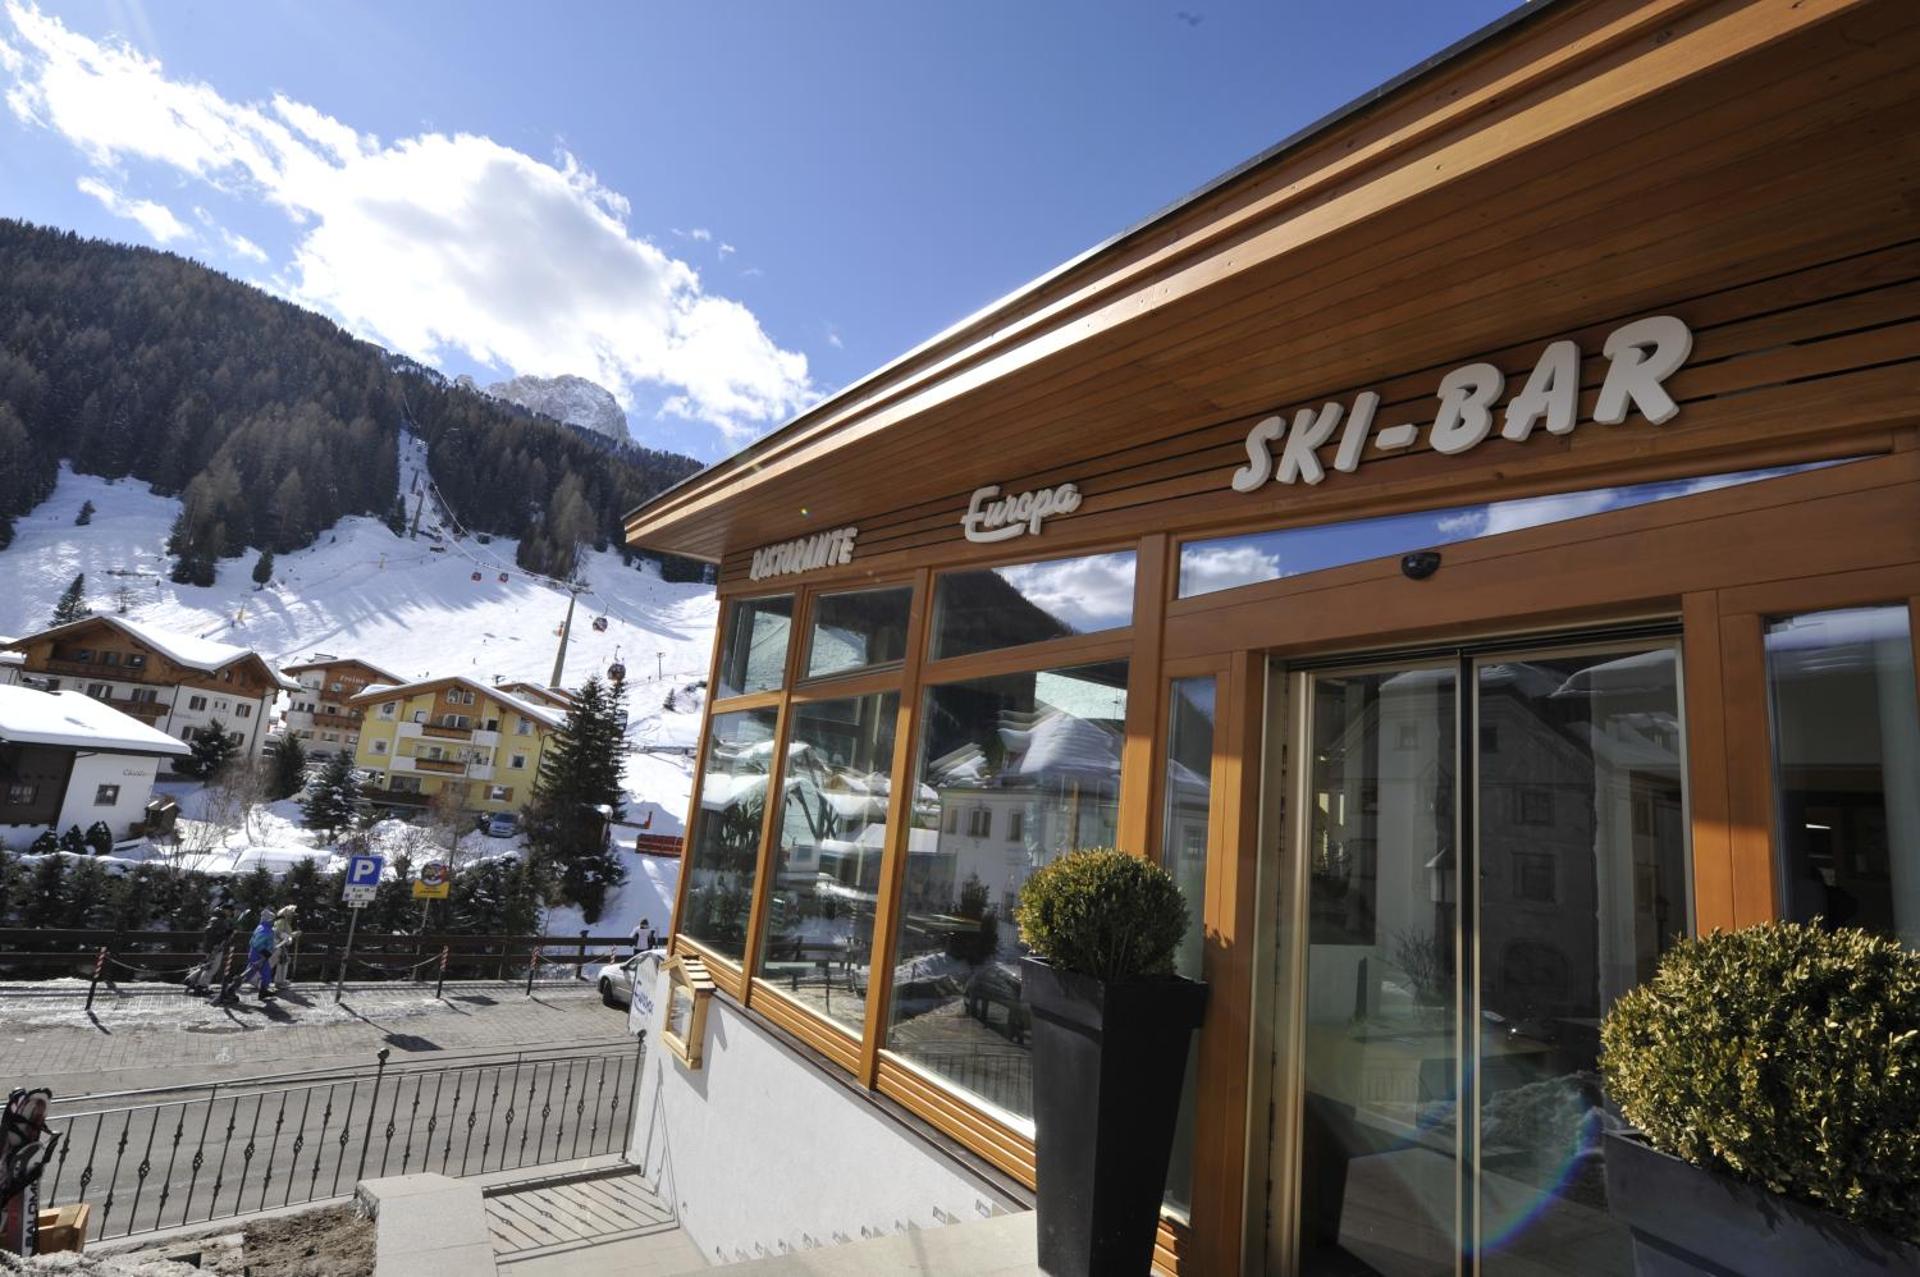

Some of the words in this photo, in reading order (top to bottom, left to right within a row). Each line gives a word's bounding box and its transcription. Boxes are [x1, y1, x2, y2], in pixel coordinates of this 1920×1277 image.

[1232, 315, 1693, 493] SKI-BAR
[961, 483, 1082, 543] Europa
[749, 527, 858, 581] RISTORANTE
[353, 860, 375, 882] P
